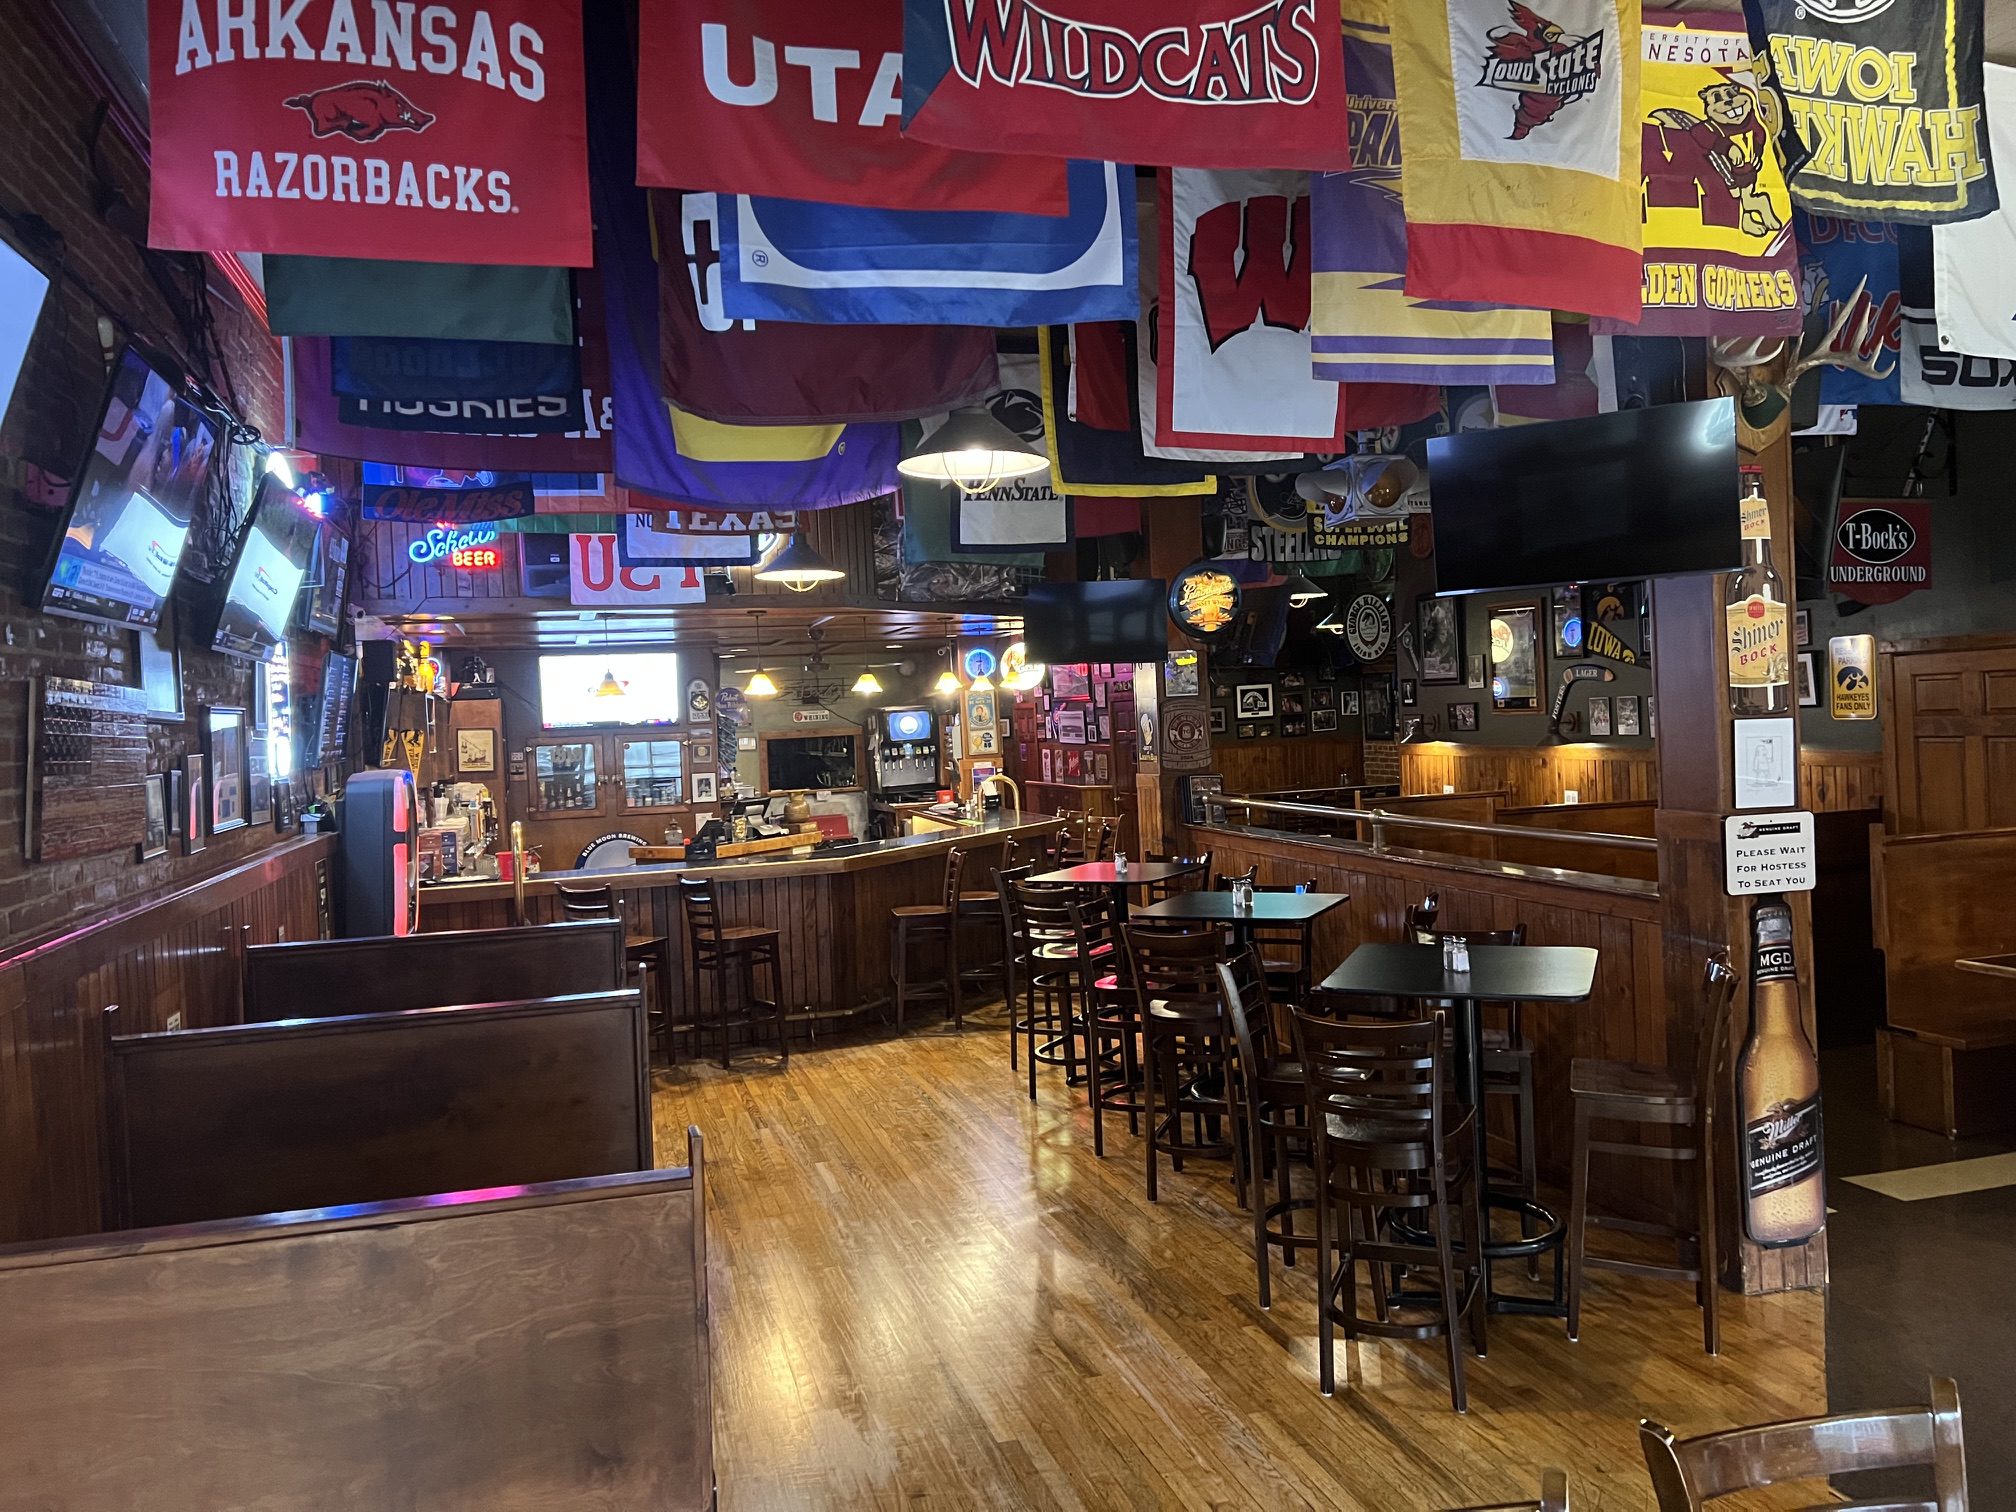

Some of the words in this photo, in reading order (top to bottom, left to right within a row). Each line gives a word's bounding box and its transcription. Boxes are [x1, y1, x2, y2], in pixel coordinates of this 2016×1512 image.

[175, 0, 545, 102] ARKANSAS
[945, 0, 1319, 105] WILDCATS
[1648, 43, 1749, 63] NESOTA
[1723, 38, 1741, 46] OF
[1546, 72, 1597, 95] CYCLONES
[214, 151, 511, 213] RAZORBACKS
[1703, 263, 1797, 312] GOPHERS
[375, 487, 436, 519] Ole
[436, 489, 523, 521] Miss
[1314, 532, 1409, 547] CHAMPIONS
[1846, 522, 1908, 551] T-Bock's
[452, 550, 496, 567] BEER
[1830, 565, 1926, 583] UNDERGROUND
[1348, 600, 1363, 635] GEORGE
[1587, 621, 1620, 660] IOWA
[1732, 618, 1784, 653] Shiner
[1353, 642, 1372, 659] IRISH
[1374, 641, 1386, 656] RED
[1740, 644, 1777, 666] BOCK
[1575, 669, 1598, 678] LAGER
[1836, 693, 1870, 701] HAWKEYES
[1836, 702, 1853, 710] FANS
[1854, 702, 1871, 711] ONLY
[582, 842, 596, 857] BLUE
[595, 833, 617, 845] MOON
[618, 833, 648, 846] BREWING
[1736, 848, 1776, 858] PLEASE
[1779, 846, 1806, 855] WAIT
[1736, 865, 1757, 873] FOR
[1760, 862, 1807, 871] HOSTESS
[1754, 879, 1781, 887] SEAT
[1785, 877, 1806, 885] YOU
[1760, 952, 1792, 967] MGD
[1762, 1114, 1803, 1141] Miller
[1749, 1149, 1789, 1169] GENUINE
[1791, 1134, 1817, 1154] DRAFT
